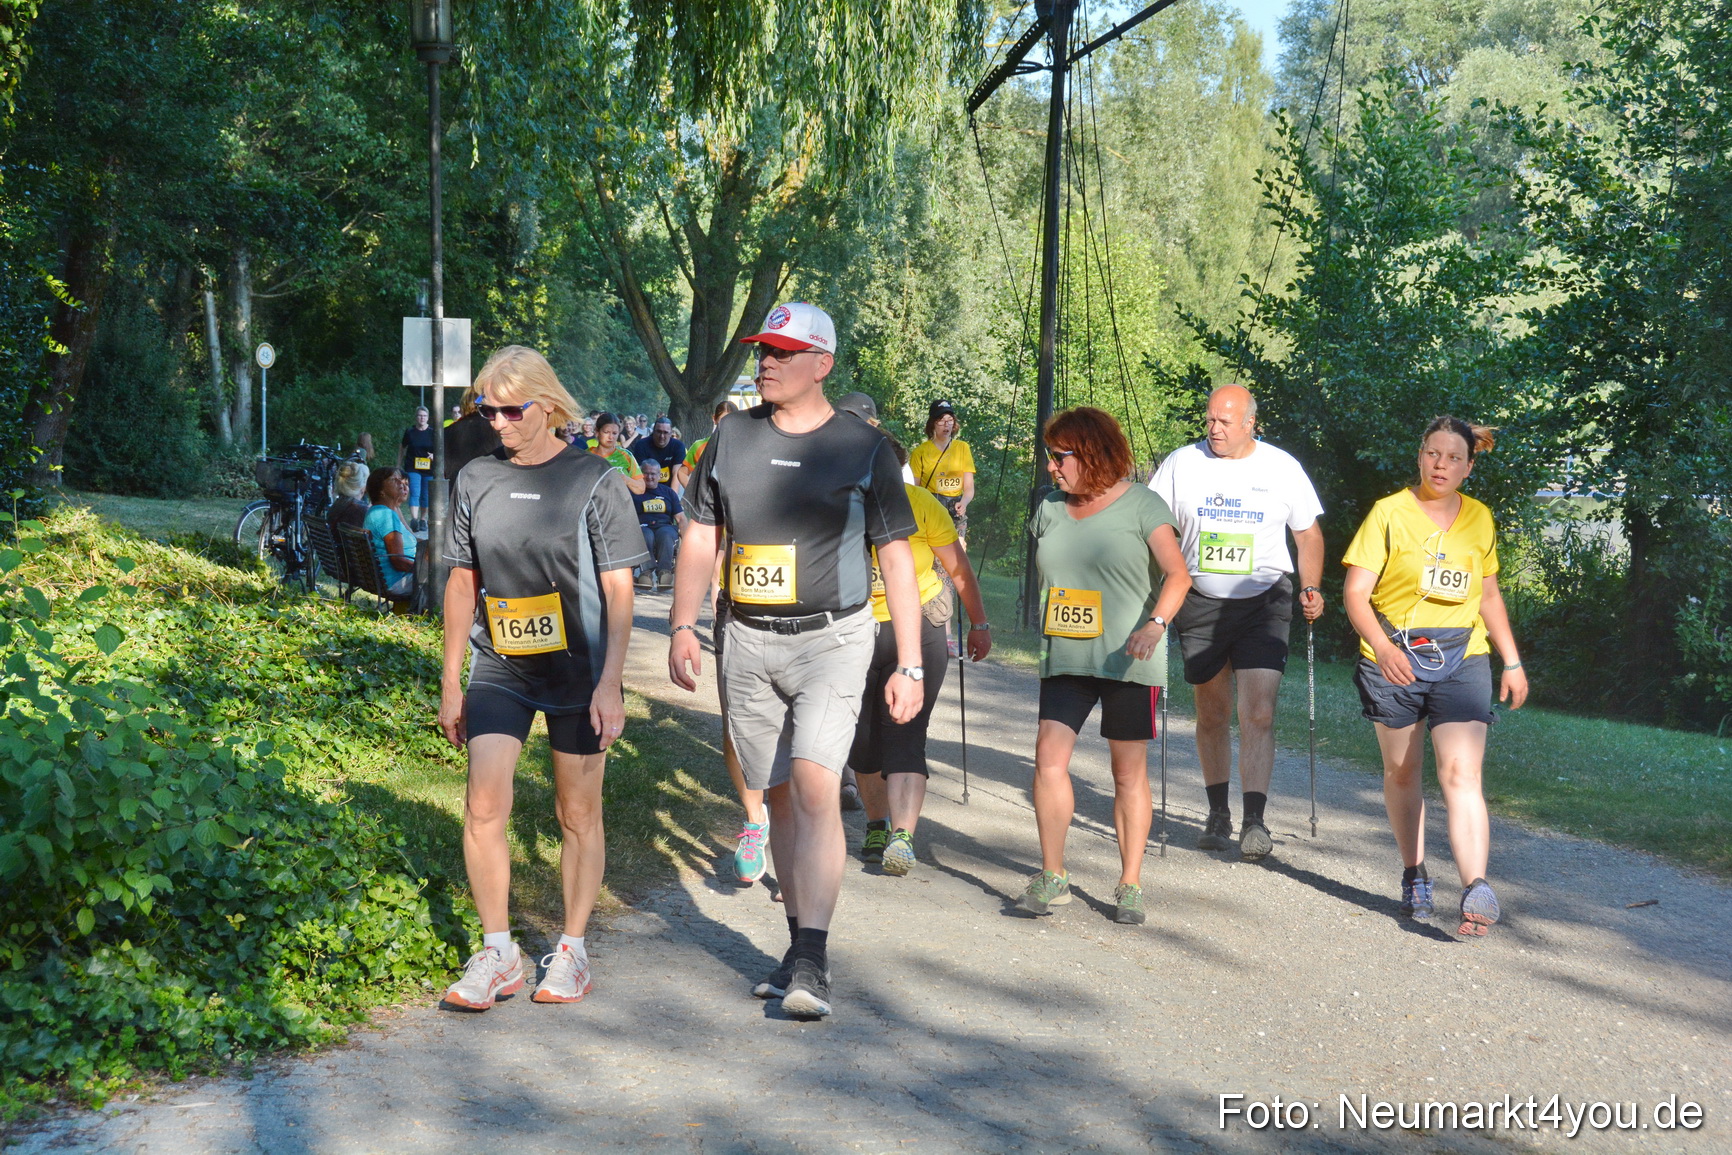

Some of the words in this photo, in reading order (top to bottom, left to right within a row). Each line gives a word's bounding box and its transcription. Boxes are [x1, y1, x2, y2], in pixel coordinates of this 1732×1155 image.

[808, 334, 828, 345] adidas
[939, 478, 960, 487] 1629
[1197, 507, 1264, 523] Engineering
[1205, 546, 1247, 562] 2147
[734, 565, 785, 587] 1634
[1429, 567, 1469, 590] 1691
[1053, 605, 1093, 624] 1655
[497, 616, 554, 638] 1648
